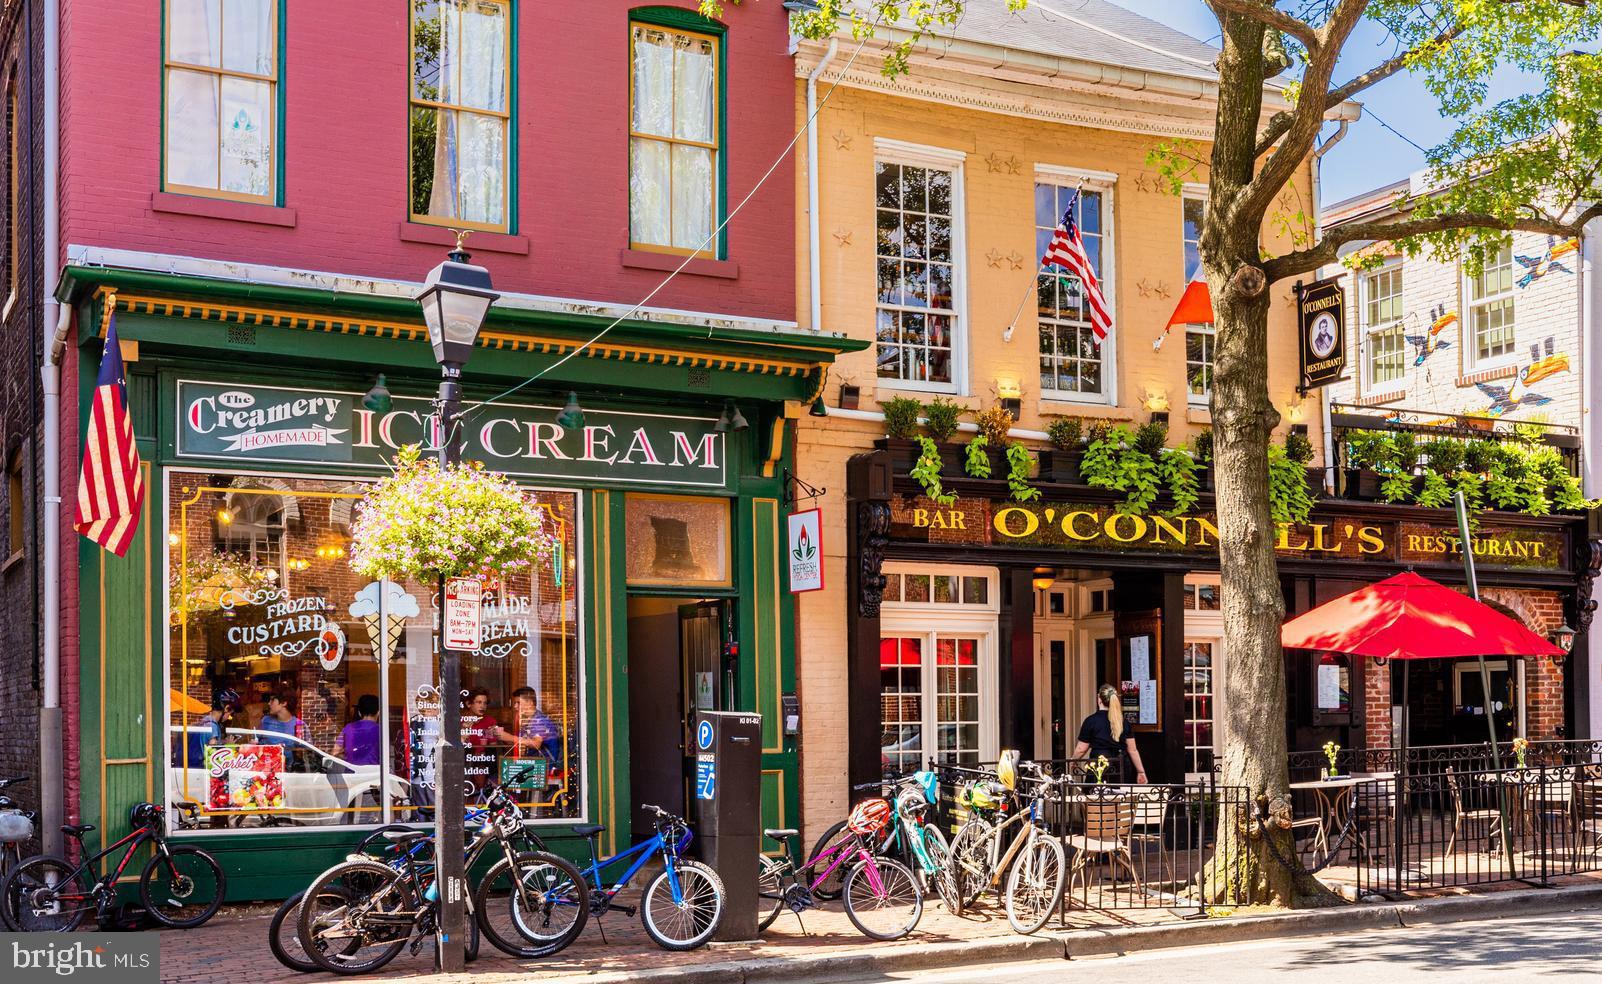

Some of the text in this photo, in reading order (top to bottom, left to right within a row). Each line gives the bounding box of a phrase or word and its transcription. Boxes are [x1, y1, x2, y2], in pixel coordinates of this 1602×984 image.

[1304, 293, 1341, 314] O'CONNELL'S
[1307, 356, 1342, 374] RESTAURANT
[223, 394, 251, 404] The
[187, 395, 342, 434] Creamery
[245, 431, 323, 448] HOMEMADE
[479, 418, 720, 469] CREAM
[912, 508, 967, 531] BAR
[993, 507, 1385, 554] O'CONNLL'S
[1406, 534, 1545, 559] RESTURANT
[792, 562, 818, 575] REFRESH
[266, 596, 326, 619] FROZEN
[451, 600, 476, 609] LOADING
[455, 610, 471, 618] ZONE
[227, 613, 327, 645] CUSTARD
[480, 619, 530, 643] REAM
[701, 726, 709, 745] P
[210, 747, 258, 778] Sorbet
[465, 754, 496, 762] Sorbet
[418, 768, 432, 776] No
